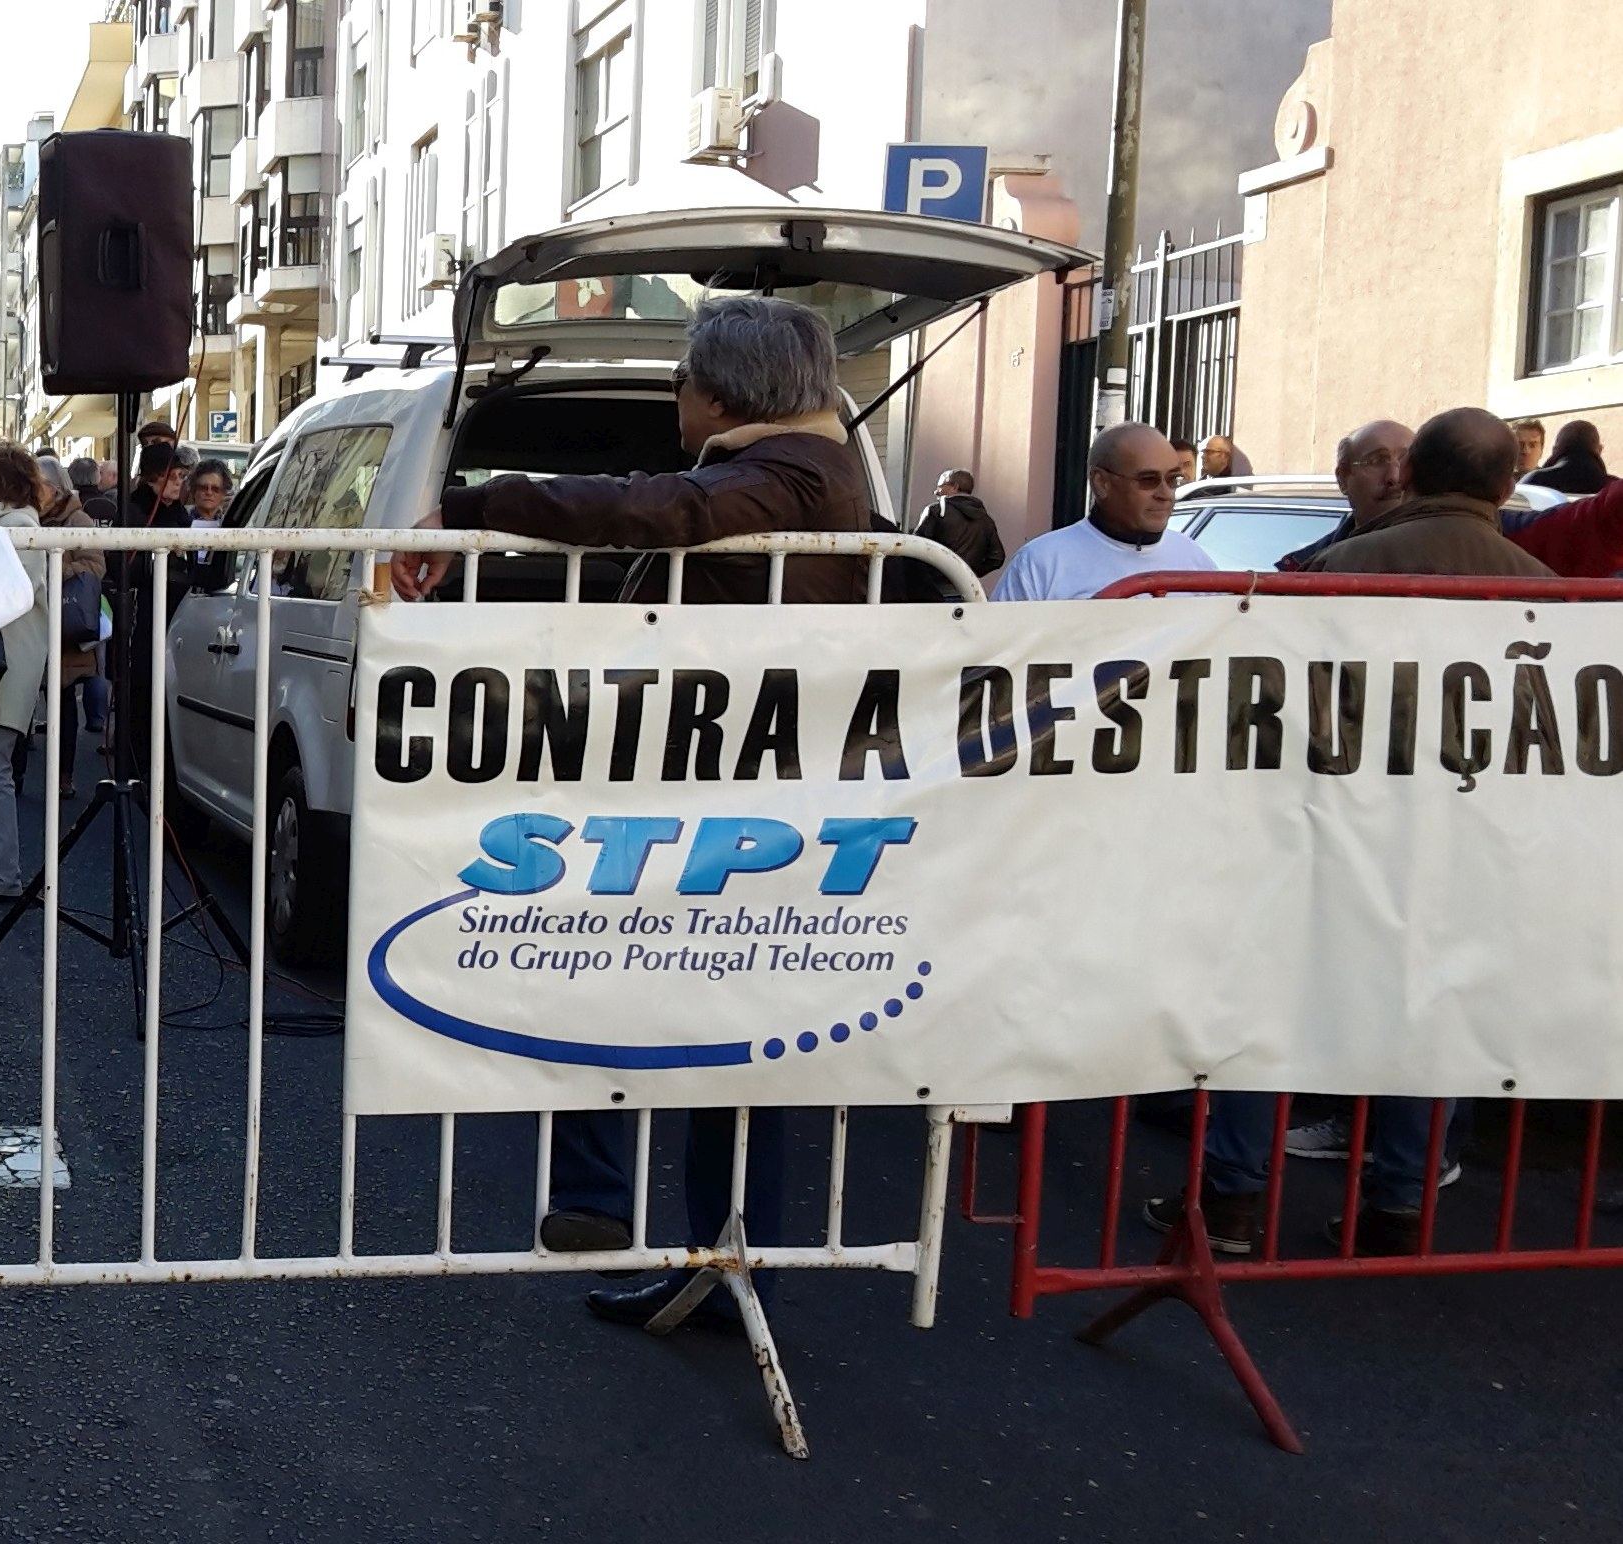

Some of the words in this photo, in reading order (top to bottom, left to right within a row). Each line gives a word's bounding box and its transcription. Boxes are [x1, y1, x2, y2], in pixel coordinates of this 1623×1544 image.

[906, 158, 962, 214] P
[375, 666, 802, 783] CONTRA
[838, 669, 911, 781] A
[957, 641, 1623, 793] DESTRUIÇÃO
[458, 812, 919, 896] STPT
[459, 905, 608, 934] Sindicato
[618, 906, 674, 934] dos
[687, 906, 908, 935] Trabalhadores
[457, 940, 499, 969] do
[510, 942, 613, 980] Grupo
[623, 942, 758, 980] Portugal
[768, 942, 895, 971] Telecom
